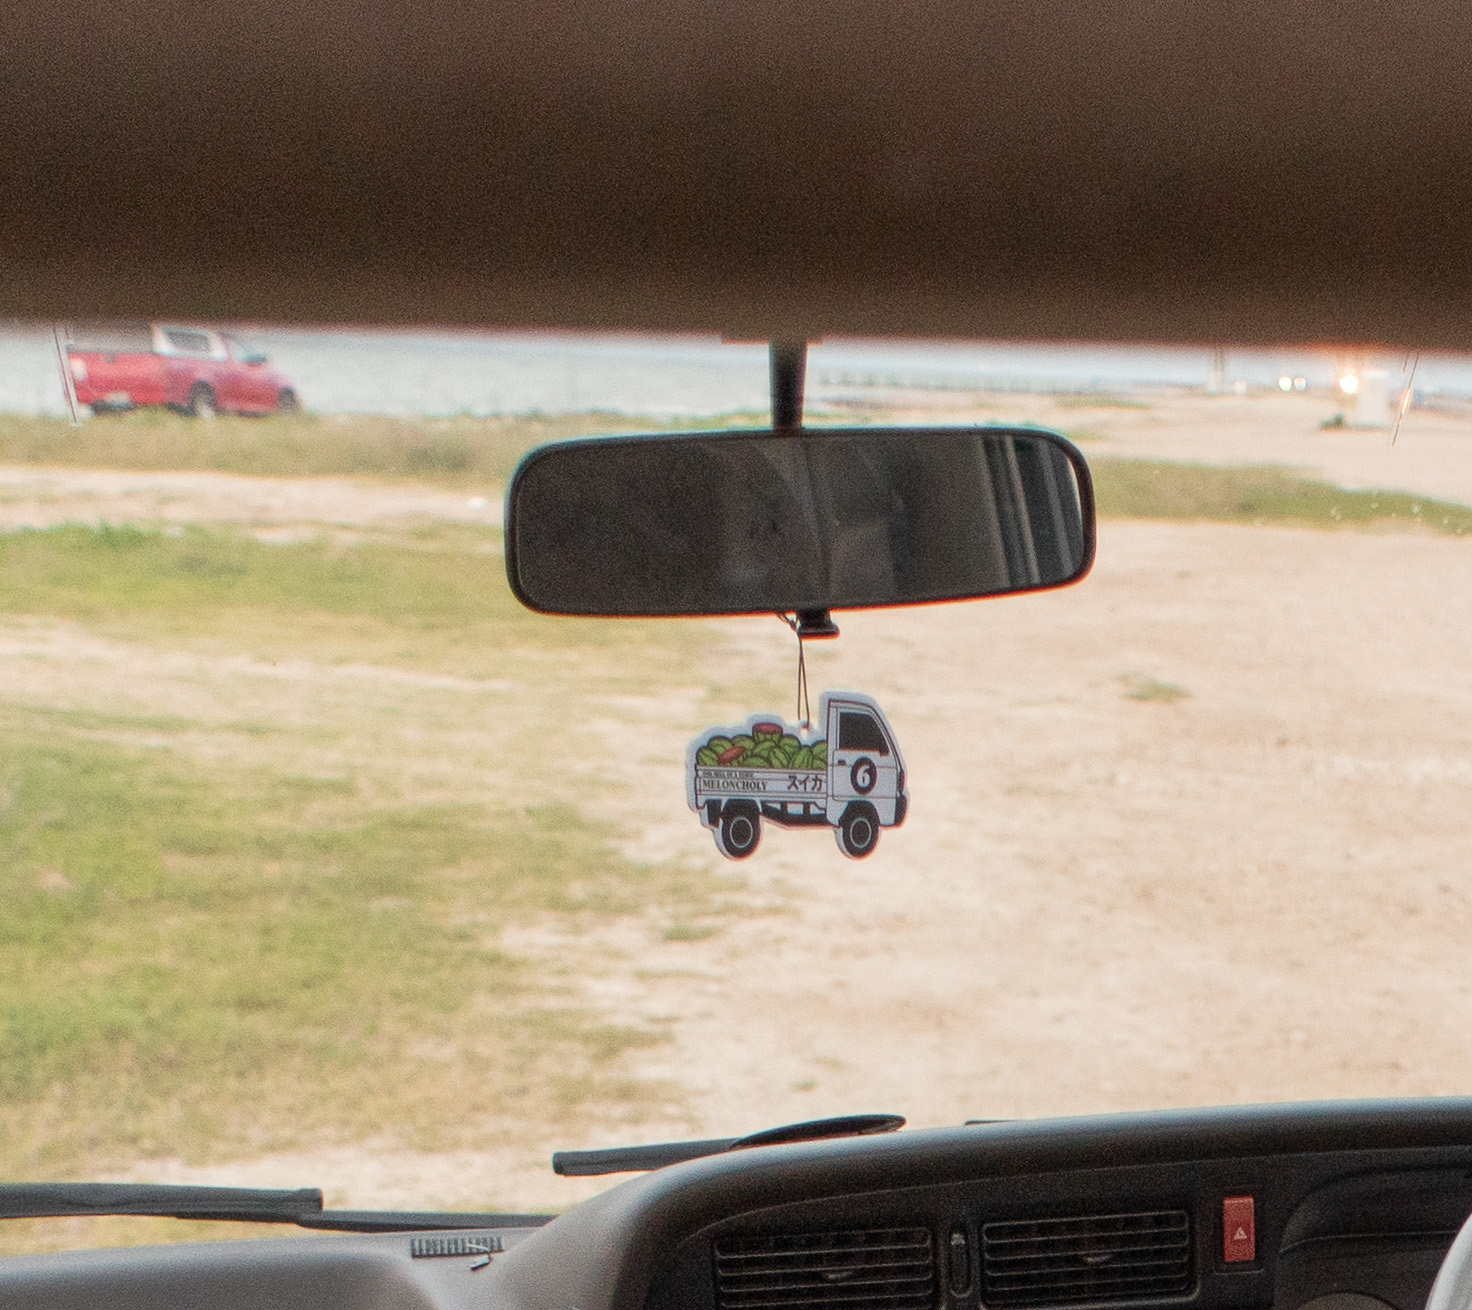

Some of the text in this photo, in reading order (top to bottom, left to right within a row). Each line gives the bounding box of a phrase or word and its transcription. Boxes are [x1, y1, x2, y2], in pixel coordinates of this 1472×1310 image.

[702, 779, 768, 792] MELONCHOLY
[786, 774, 824, 792] スイカ
[855, 763, 872, 790] 6
